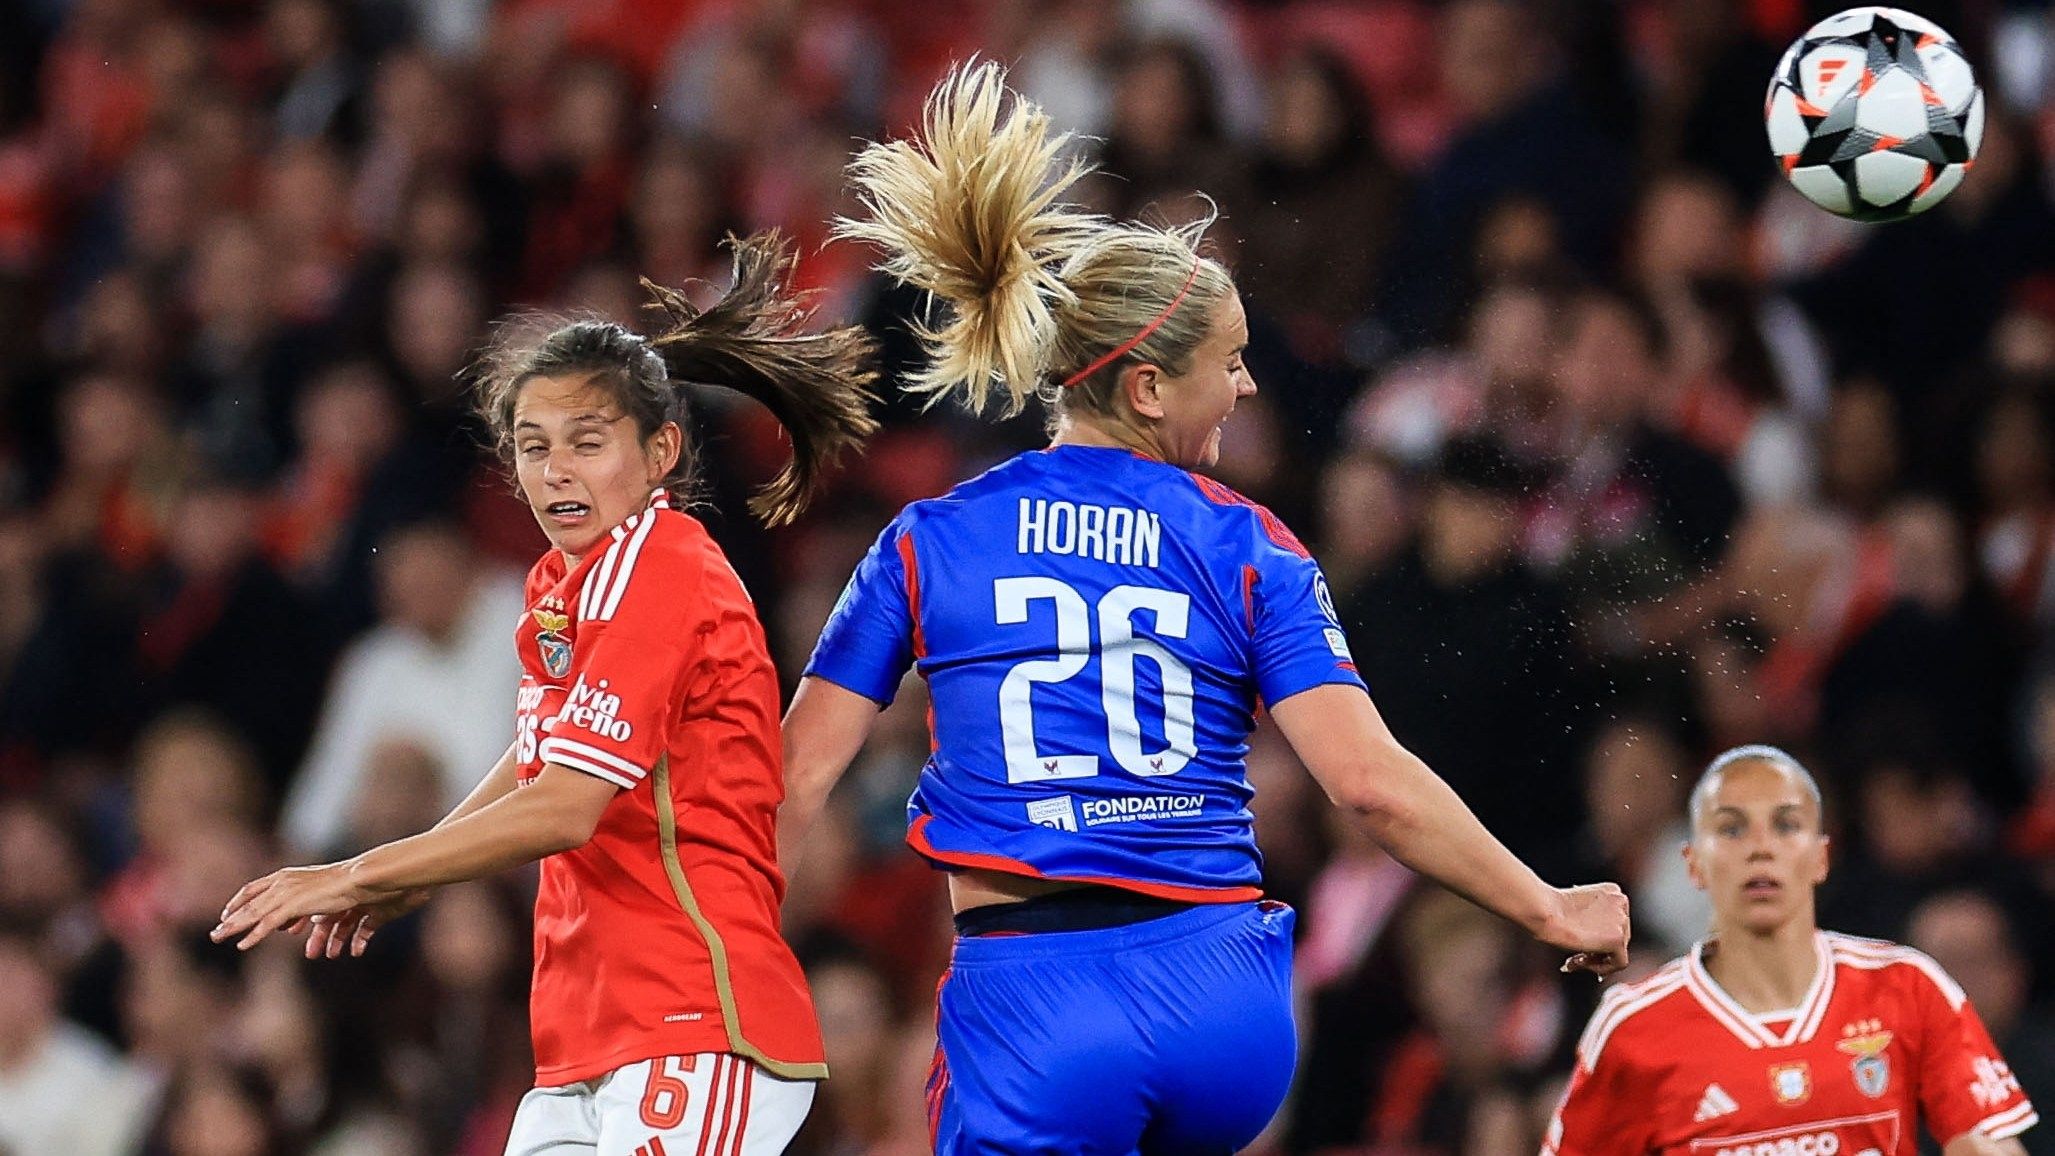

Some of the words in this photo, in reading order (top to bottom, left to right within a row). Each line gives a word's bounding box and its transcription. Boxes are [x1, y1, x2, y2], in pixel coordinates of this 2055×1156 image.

[1018, 498, 1160, 567] HORAN
[994, 577, 1198, 784] 26
[1082, 794, 1205, 819] FONDATION
[639, 1055, 697, 1130] 6
